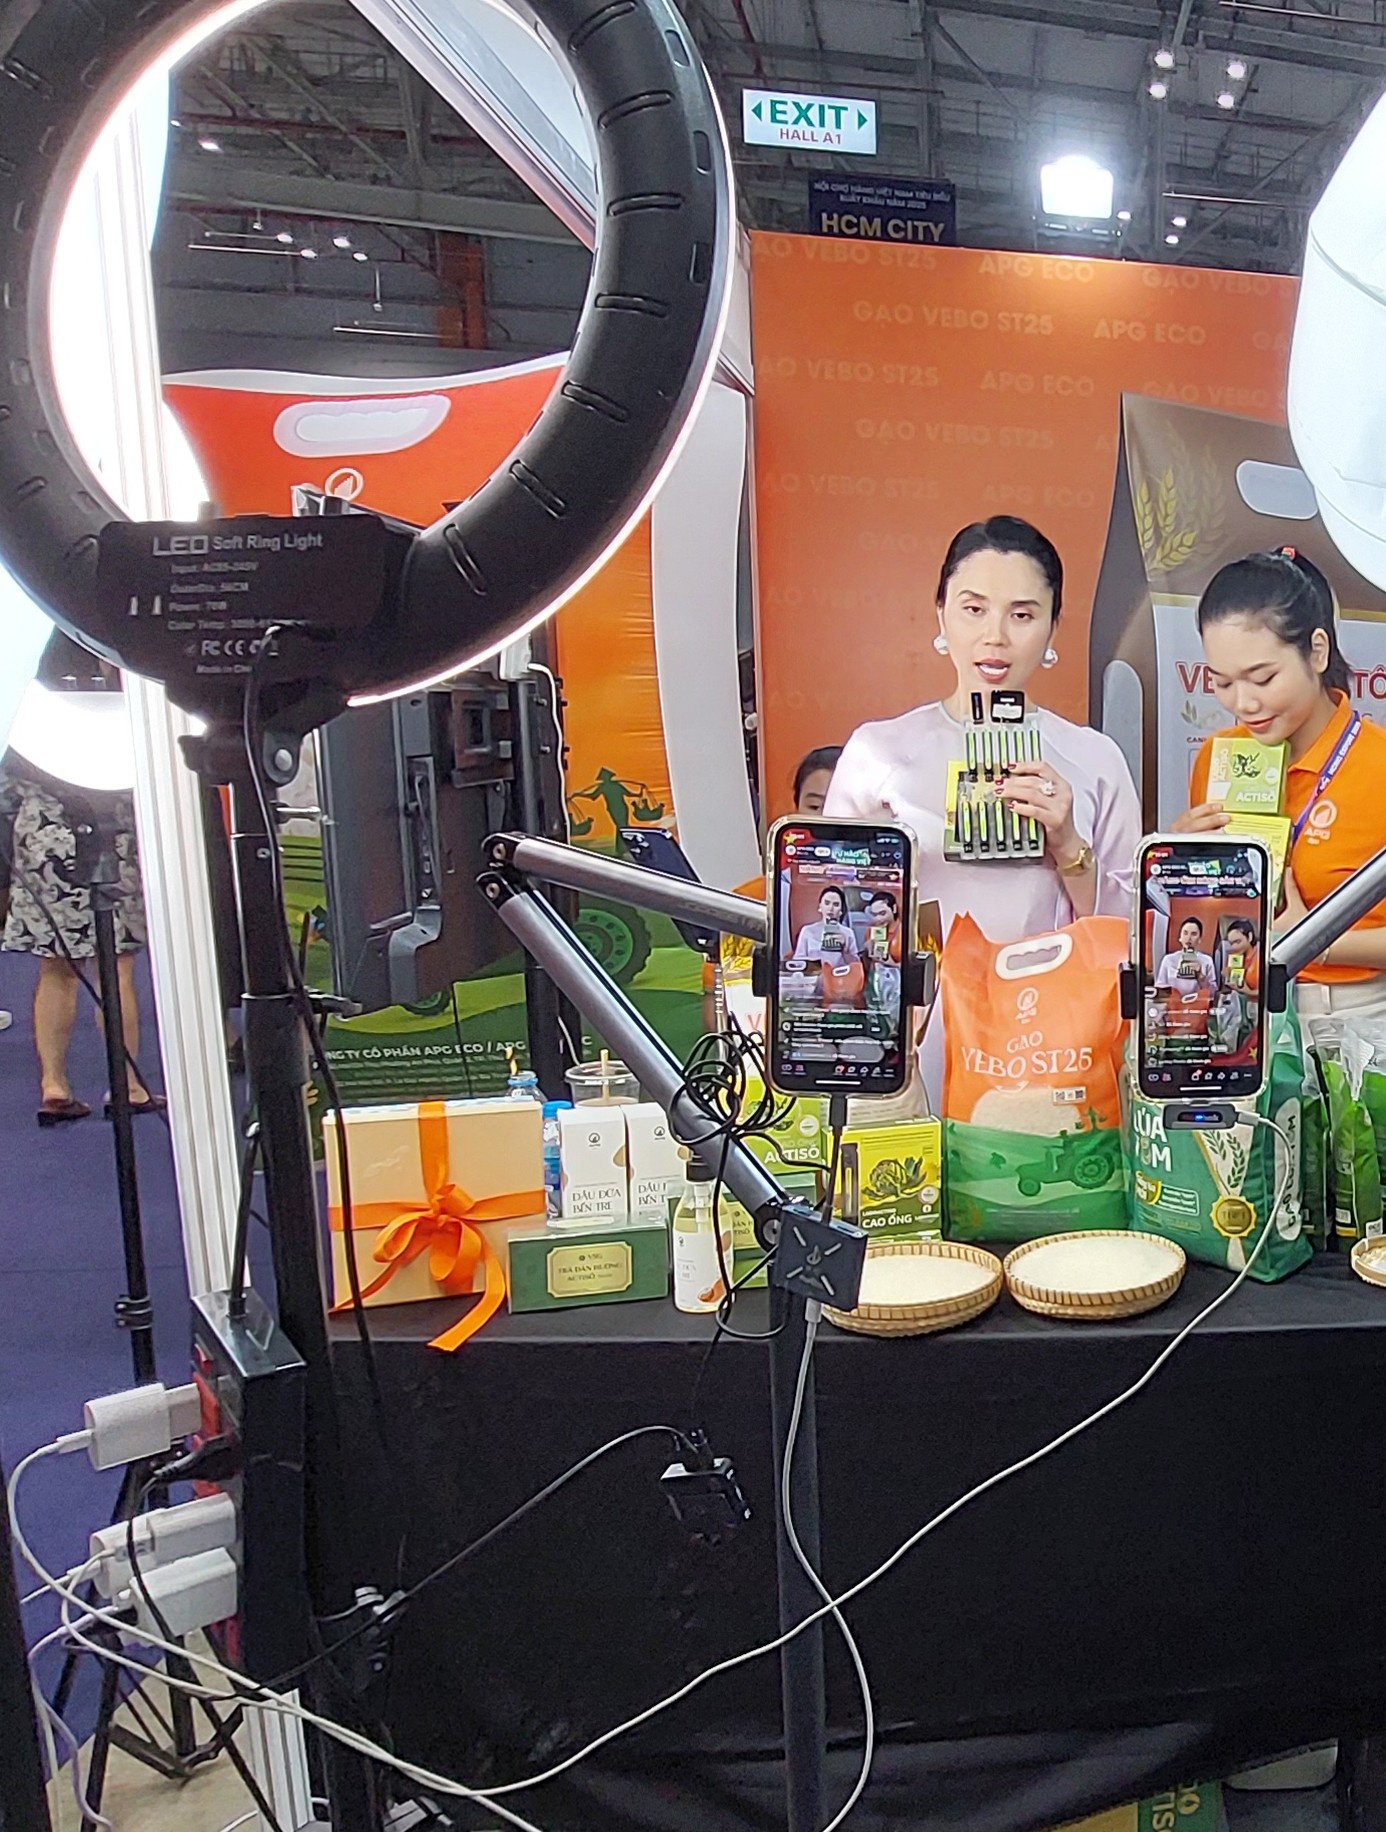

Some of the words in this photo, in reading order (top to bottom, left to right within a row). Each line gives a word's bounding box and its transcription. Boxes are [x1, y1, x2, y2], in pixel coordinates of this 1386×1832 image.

[770, 99, 848, 129] EXIT
[779, 128, 818, 143] HALL
[823, 132, 842, 144] A1
[821, 211, 882, 238] HCM
[887, 218, 945, 242] CITY
[802, 238, 870, 266] VEBO
[877, 248, 937, 271] ST25
[978, 253, 1034, 278] APG
[1041, 259, 1095, 284] ECO
[853, 299, 913, 329] GẠO
[922, 304, 989, 331] VEBO
[997, 310, 1055, 336] ST25
[1093, 317, 1147, 343] APG
[1154, 322, 1206, 346] ECO
[979, 369, 1035, 393] APG
[1043, 373, 1095, 398] ECO
[152, 534, 209, 556] LED
[213, 535, 242, 550] Soft
[247, 534, 281, 551] Ring
[284, 532, 323, 550] Light
[1176, 662, 1216, 695] VE
[424, 1045, 452, 1056] APG
[960, 1045, 1028, 1079] VEBO
[1030, 1047, 1093, 1076] ST25
[862, 1215, 887, 1230] CAO
[887, 1210, 913, 1227] ỐNG
